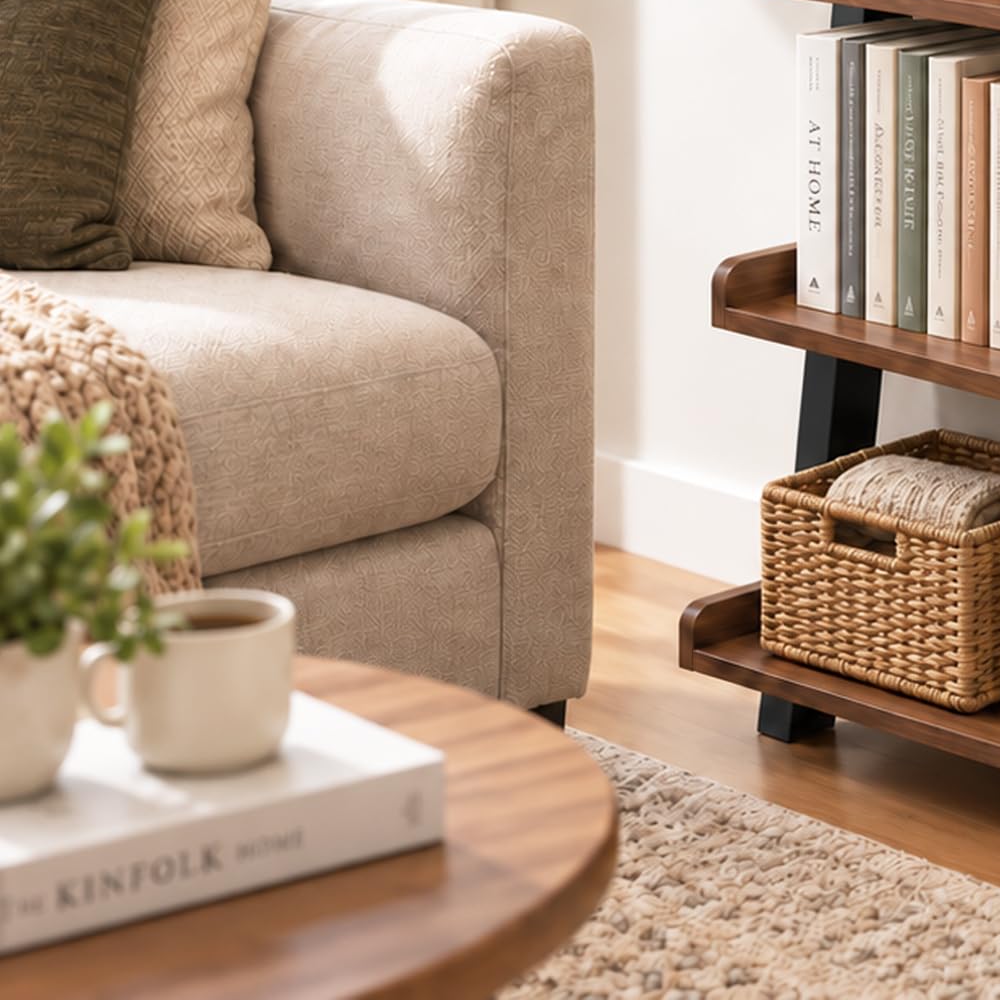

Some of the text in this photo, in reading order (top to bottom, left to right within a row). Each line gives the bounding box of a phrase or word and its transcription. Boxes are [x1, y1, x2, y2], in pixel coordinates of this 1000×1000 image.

[808, 120, 822, 233] AT HOME
[54, 840, 224, 911] KINFOLK
